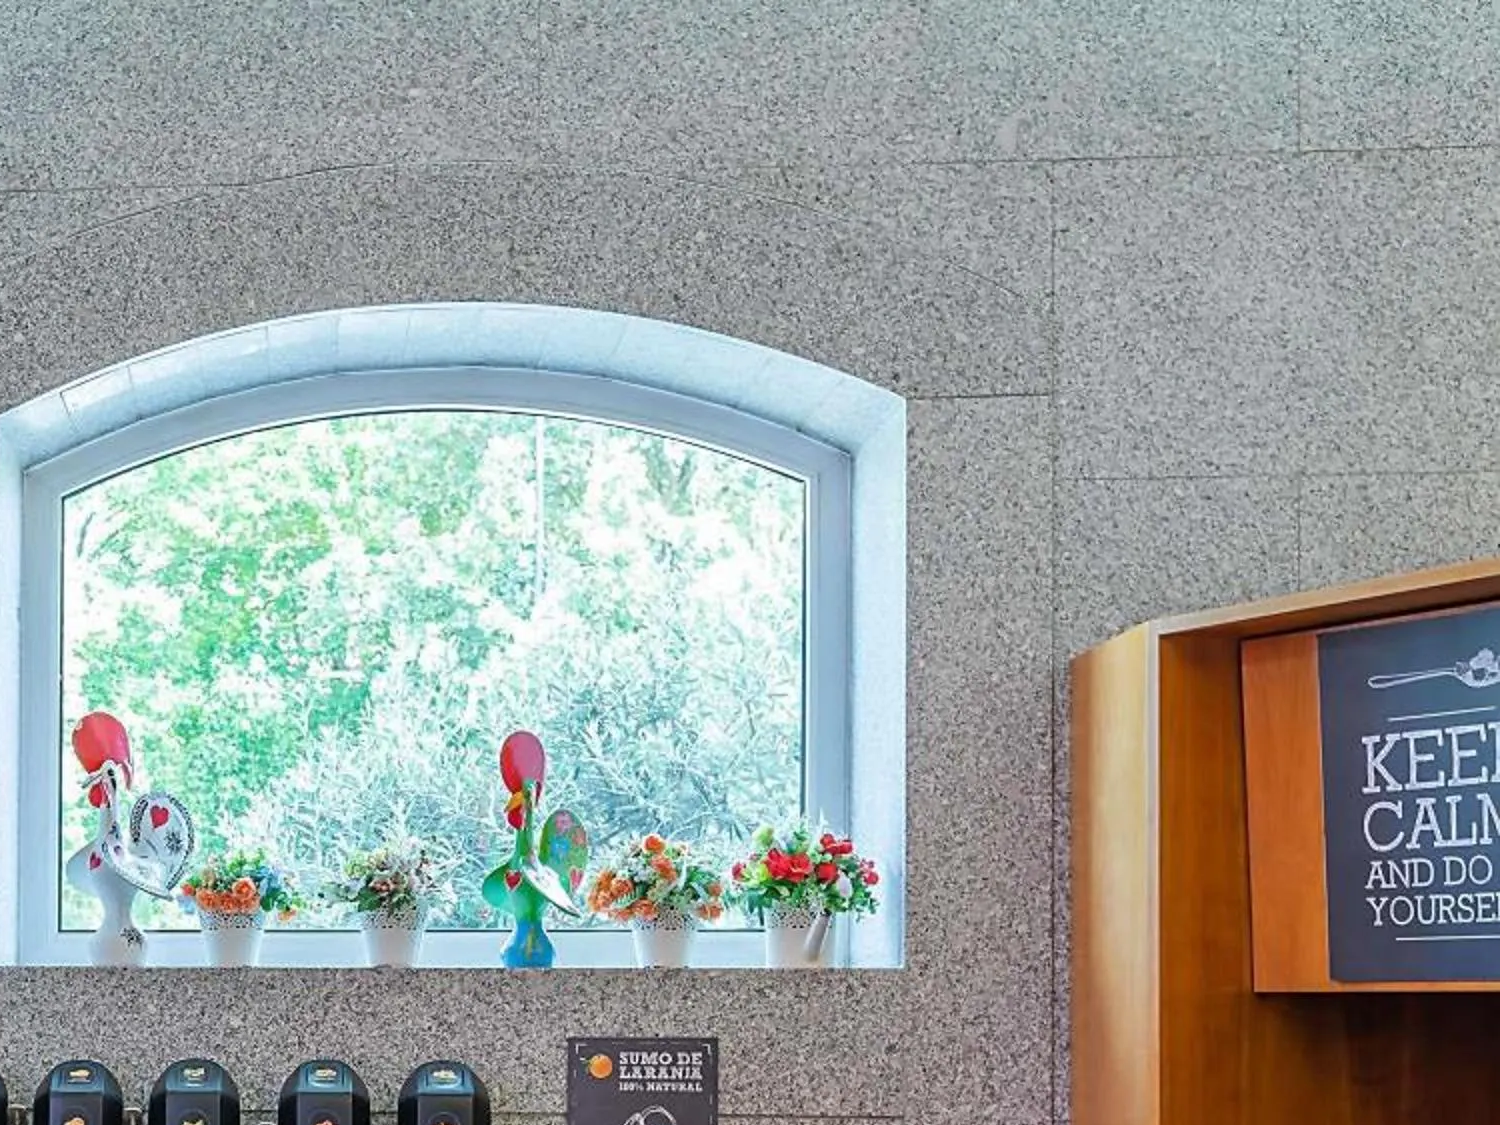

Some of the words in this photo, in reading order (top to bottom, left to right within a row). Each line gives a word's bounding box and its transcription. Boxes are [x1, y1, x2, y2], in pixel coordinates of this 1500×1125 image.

[1364, 858, 1435, 890] AND
[1442, 854, 1493, 886] DO
[1365, 892, 1500, 927] YOURSE
[619, 1051, 673, 1065] SUMO
[677, 1051, 703, 1066] DE
[646, 1081, 704, 1092] NATURAL
